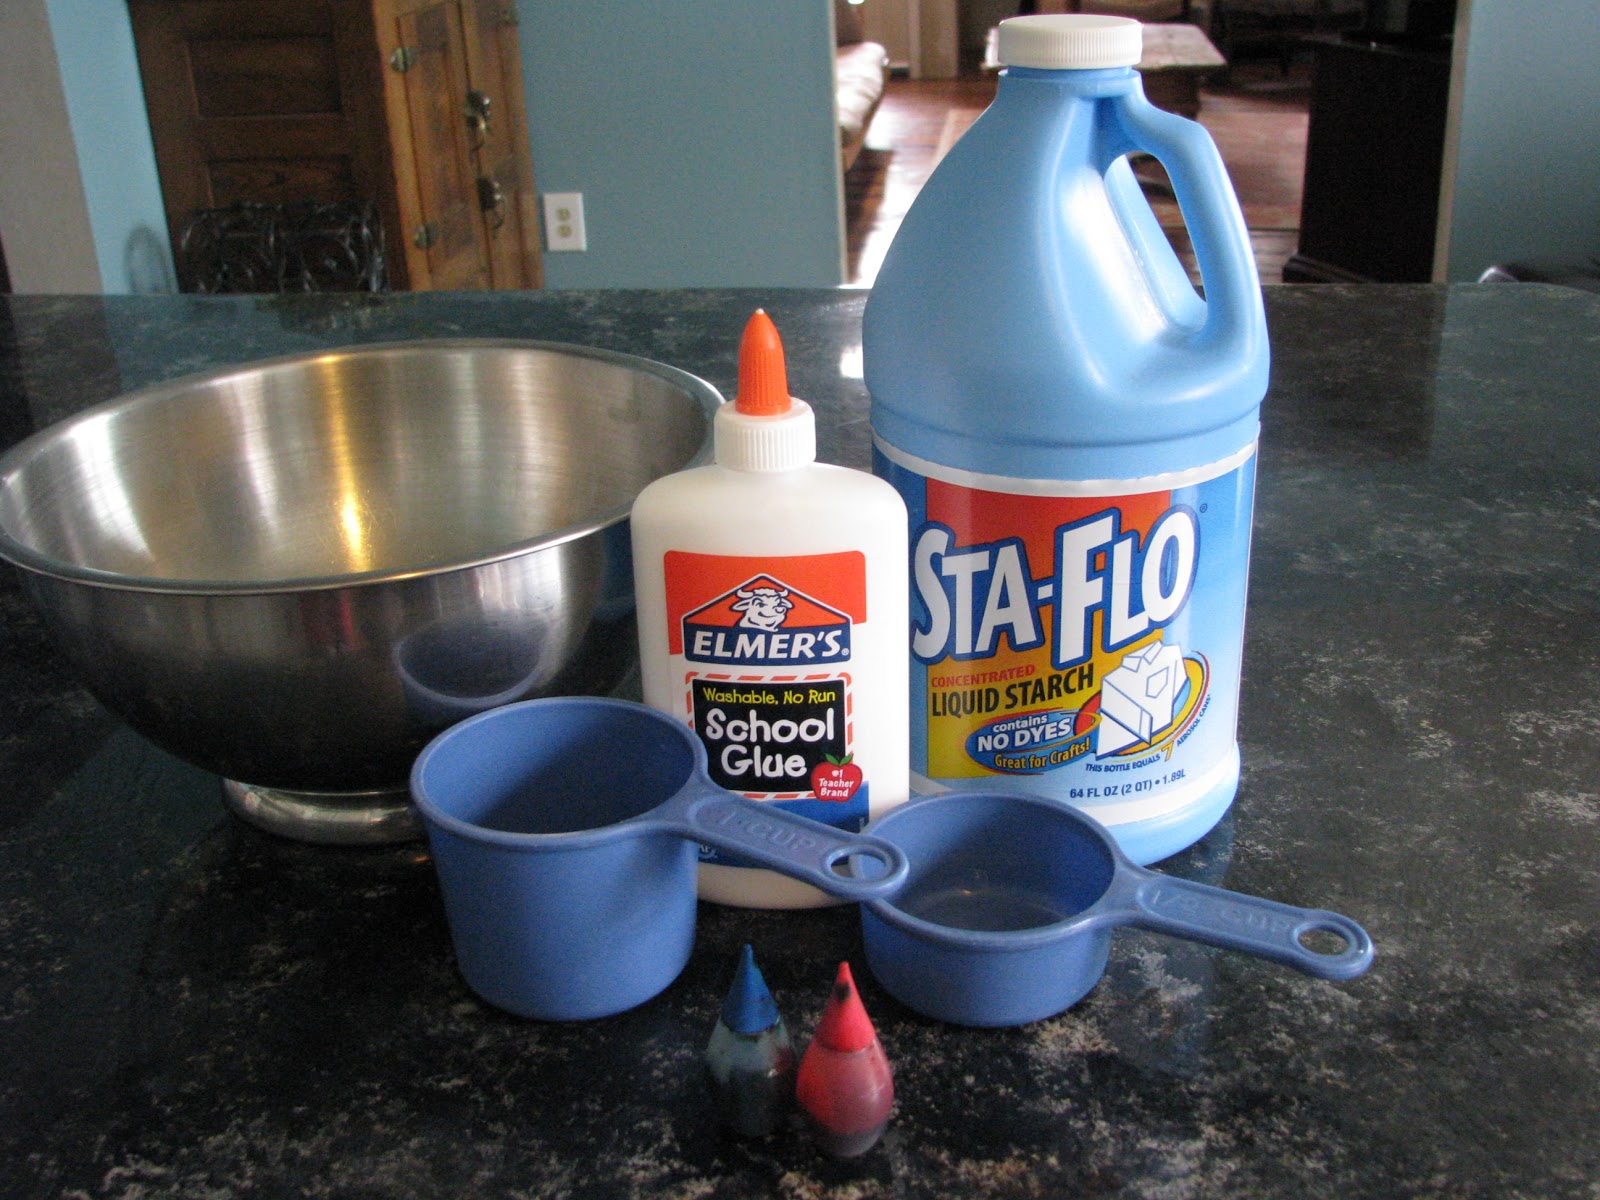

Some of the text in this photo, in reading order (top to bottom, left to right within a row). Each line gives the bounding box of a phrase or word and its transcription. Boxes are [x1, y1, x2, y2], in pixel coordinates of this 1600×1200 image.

[911, 508, 1198, 667] STA-FLO
[693, 629, 843, 658] ELMER'S
[931, 663, 1036, 688] CONCENTRATED
[931, 662, 1094, 717] LIQUID STARCH
[783, 690, 804, 705] No
[808, 689, 836, 704] Run
[705, 707, 835, 743] School
[977, 717, 1073, 752] NO DYES
[992, 714, 1048, 733] contains
[994, 737, 1091, 769] Great for Crafts!
[1085, 763, 1102, 772] THIS
[1103, 762, 1131, 772] BOTTLE
[1132, 753, 1161, 768] EQUALS
[1161, 740, 1175, 762] 7
[1176, 718, 1200, 745] AEROSOL
[721, 744, 807, 777] Glue
[831, 769, 844, 779] #1
[818, 778, 854, 788] Teacher
[820, 788, 849, 797] Brand
[1070, 769, 1187, 799] 64 FL OZ (2 QT) 1.89L
